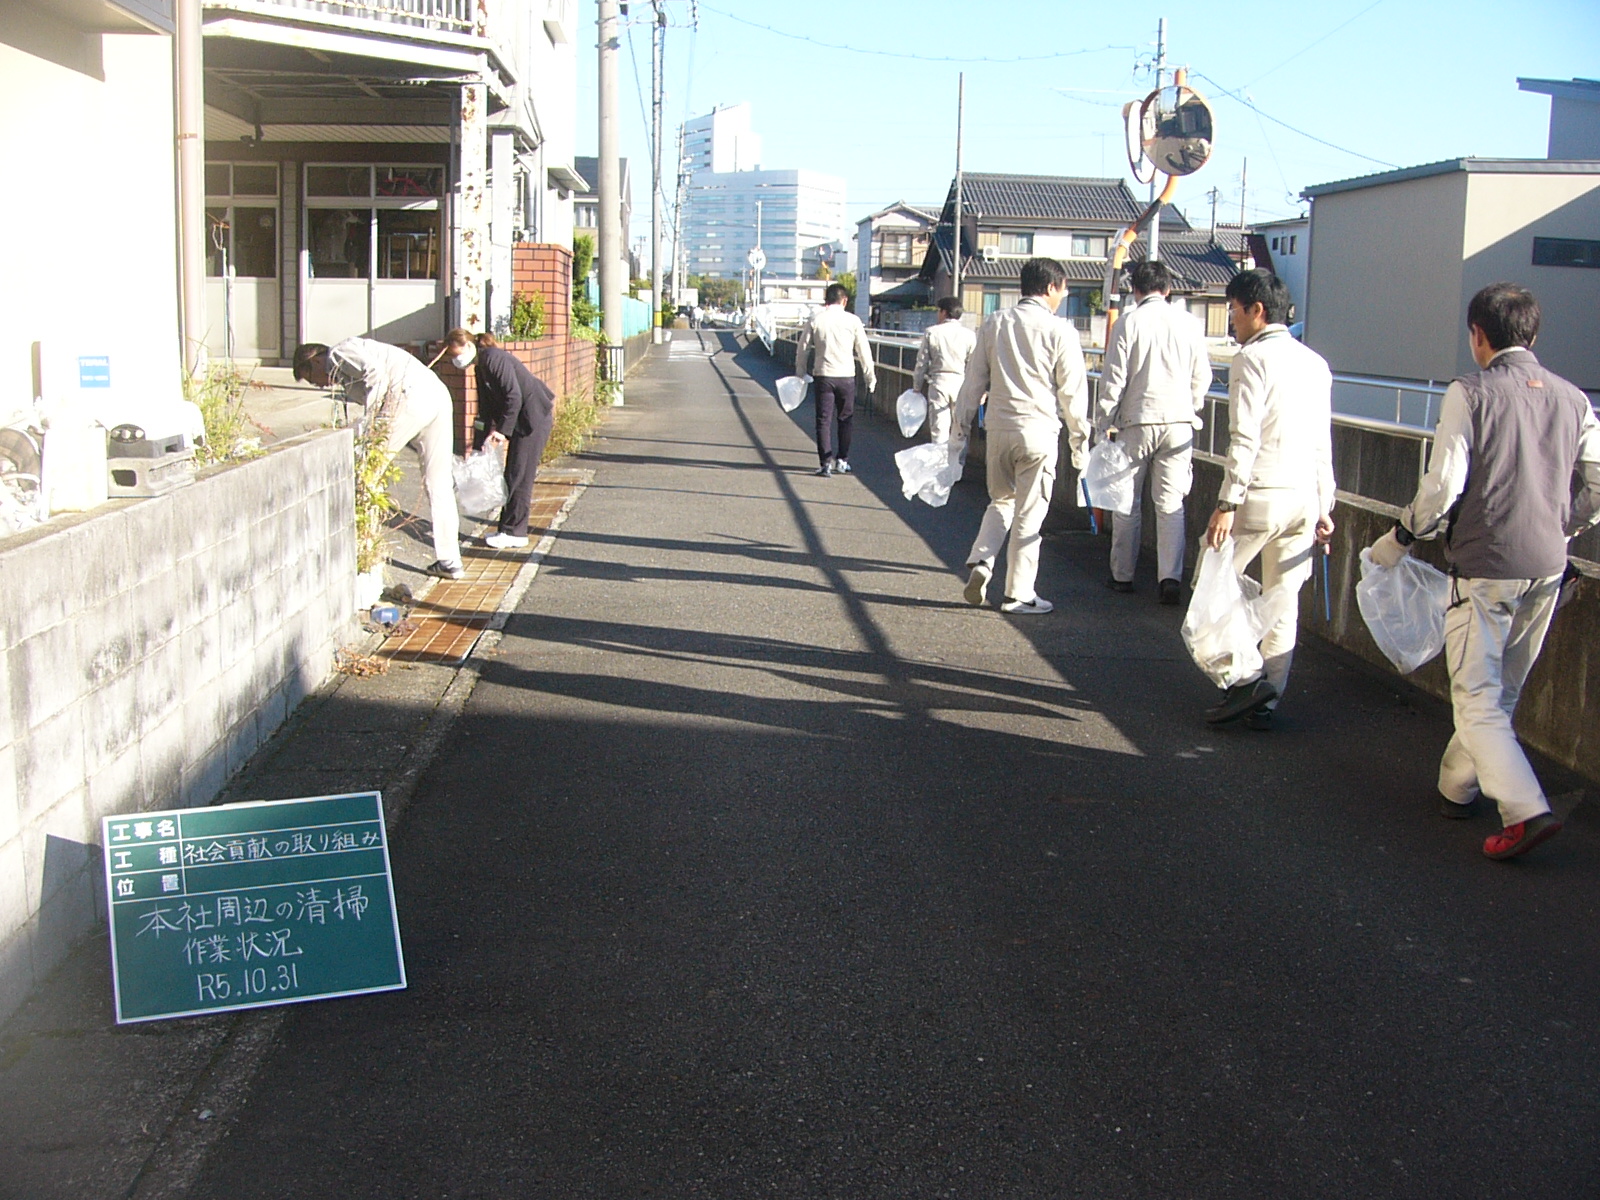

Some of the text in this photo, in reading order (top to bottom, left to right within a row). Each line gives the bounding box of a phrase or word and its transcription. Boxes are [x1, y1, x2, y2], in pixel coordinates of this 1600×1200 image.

[112, 819, 175, 841] 工事名
[184, 830, 381, 865] 社会貢献の取り組み
[135, 885, 369, 938] 本社周辺の清掃
[182, 928, 304, 965] 作業状況
[197, 963, 299, 1001] R5.10.31
